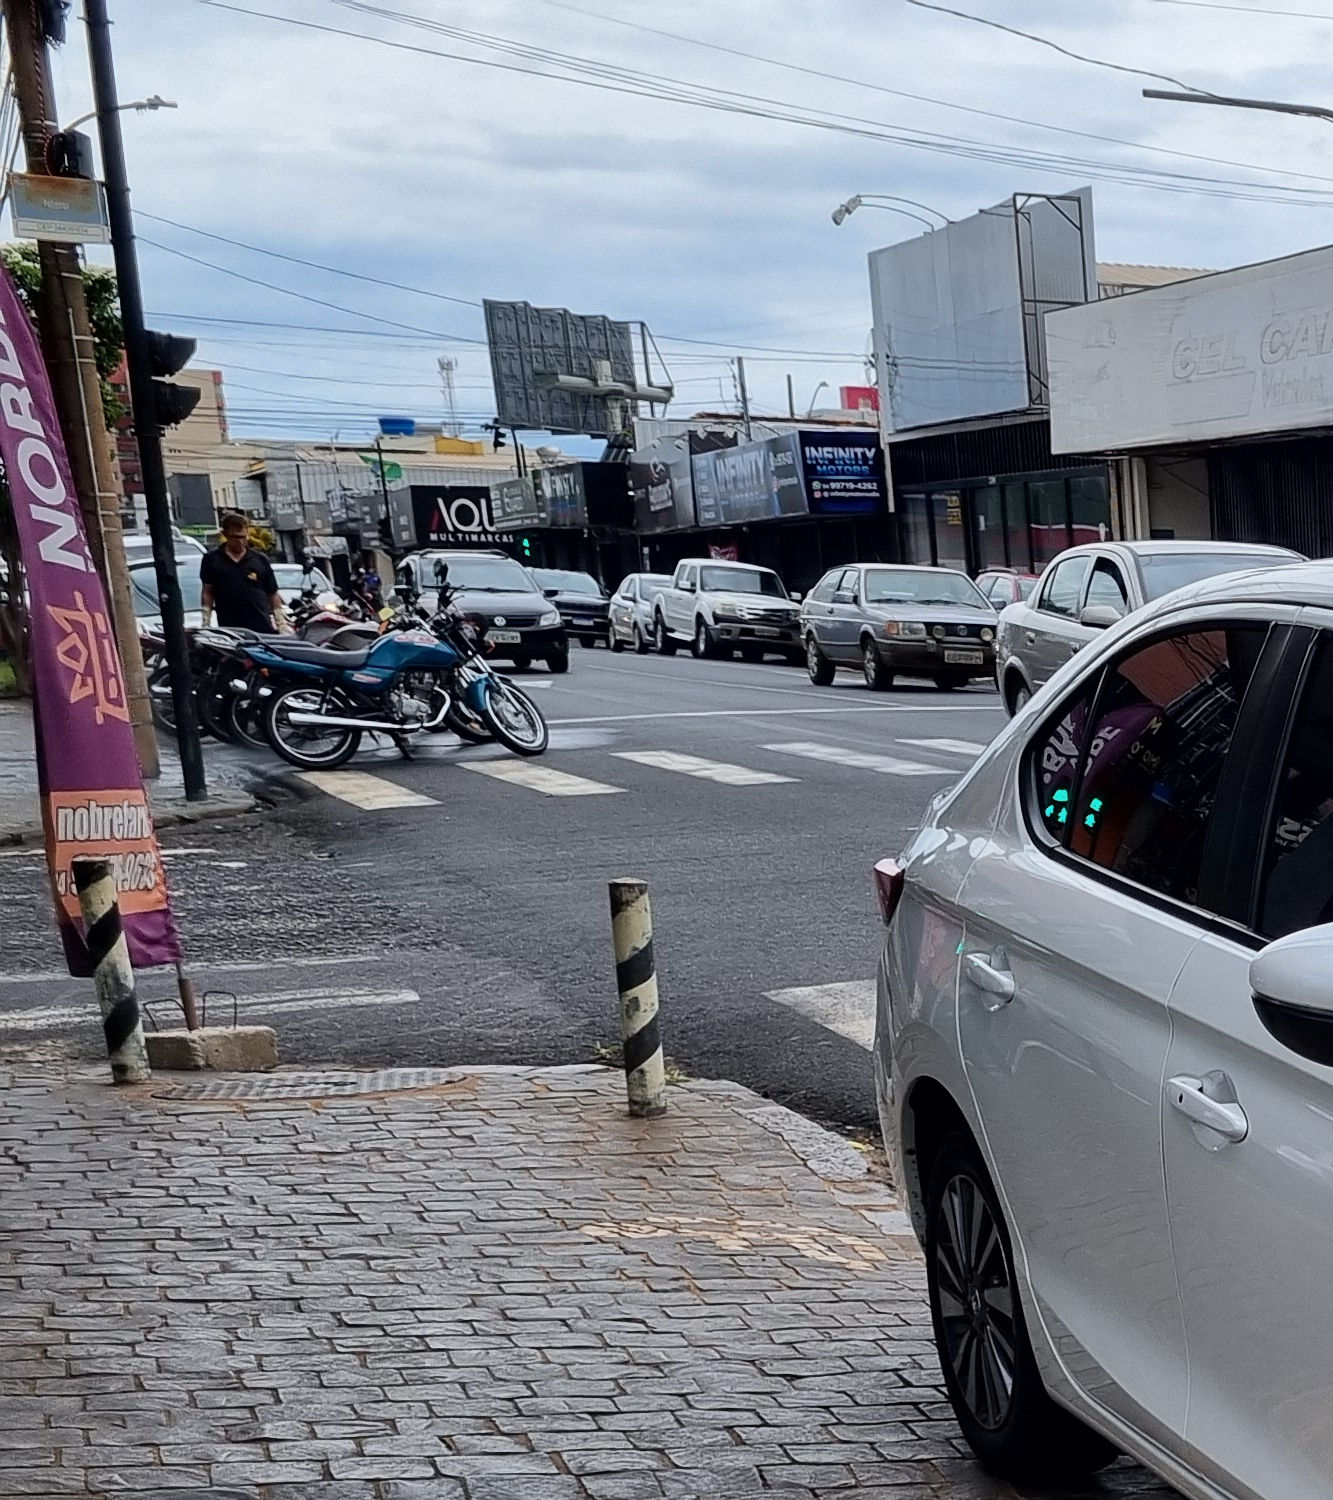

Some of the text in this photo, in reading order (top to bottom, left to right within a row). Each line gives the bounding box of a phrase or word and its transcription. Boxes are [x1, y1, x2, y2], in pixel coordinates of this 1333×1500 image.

[805, 446, 876, 465] INFINITY
[816, 465, 870, 475] MOTORS
[430, 532, 514, 543] MULTIMARCAS
